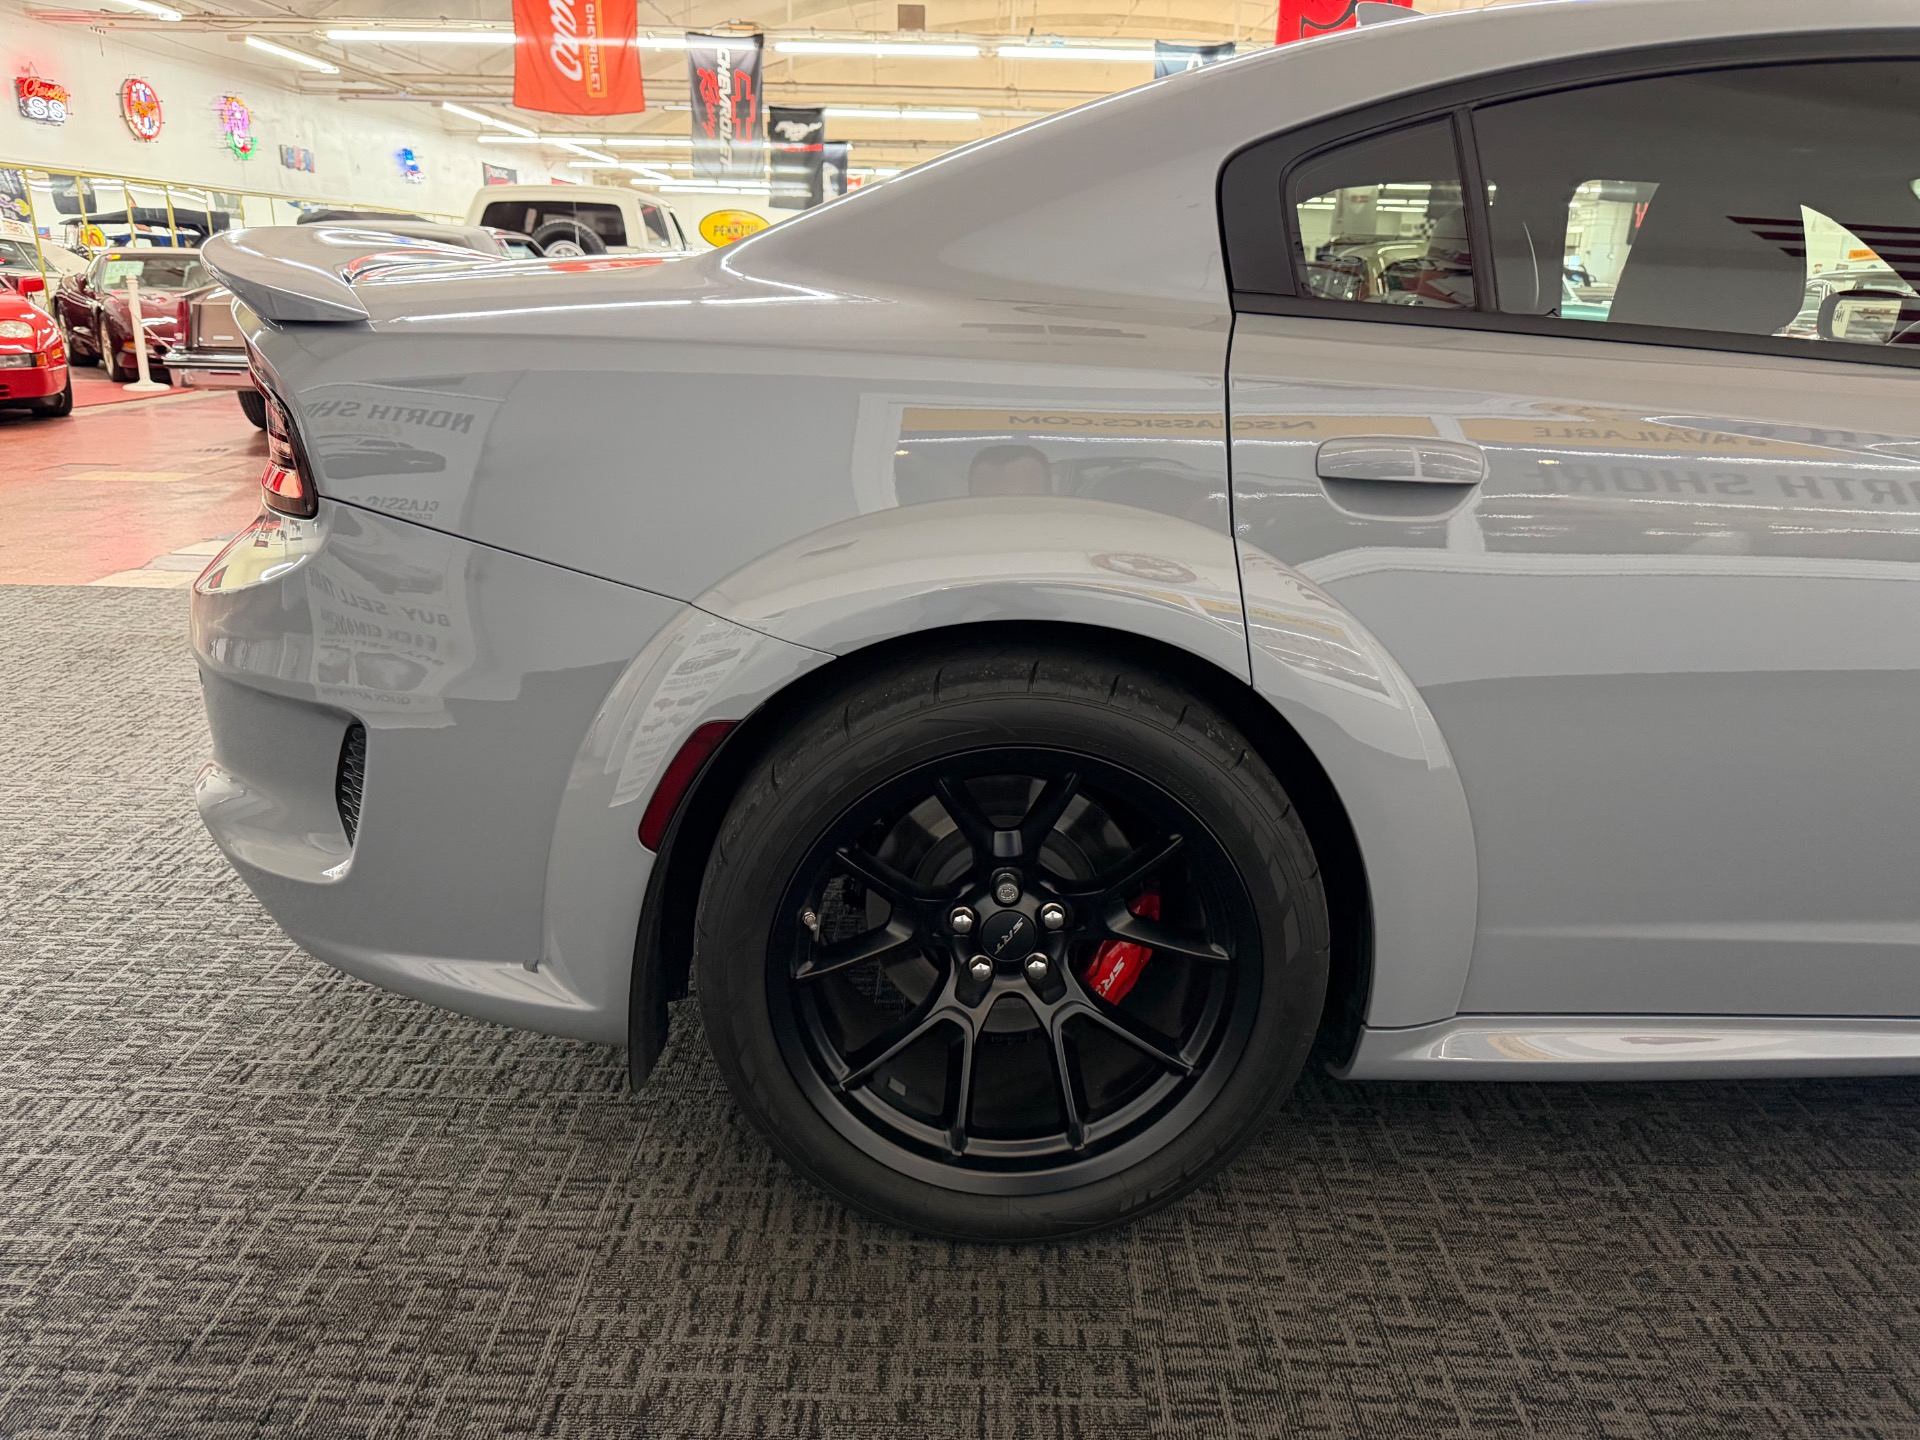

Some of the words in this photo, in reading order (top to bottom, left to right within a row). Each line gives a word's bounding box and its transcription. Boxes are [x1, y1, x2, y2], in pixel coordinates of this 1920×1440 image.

[549, 0, 583, 81] aro
[585, 3, 601, 91] CHEVROLET
[28, 96, 67, 121] SS
[716, 46, 733, 169] CHEVROLET
[994, 917, 1023, 955] SRT
